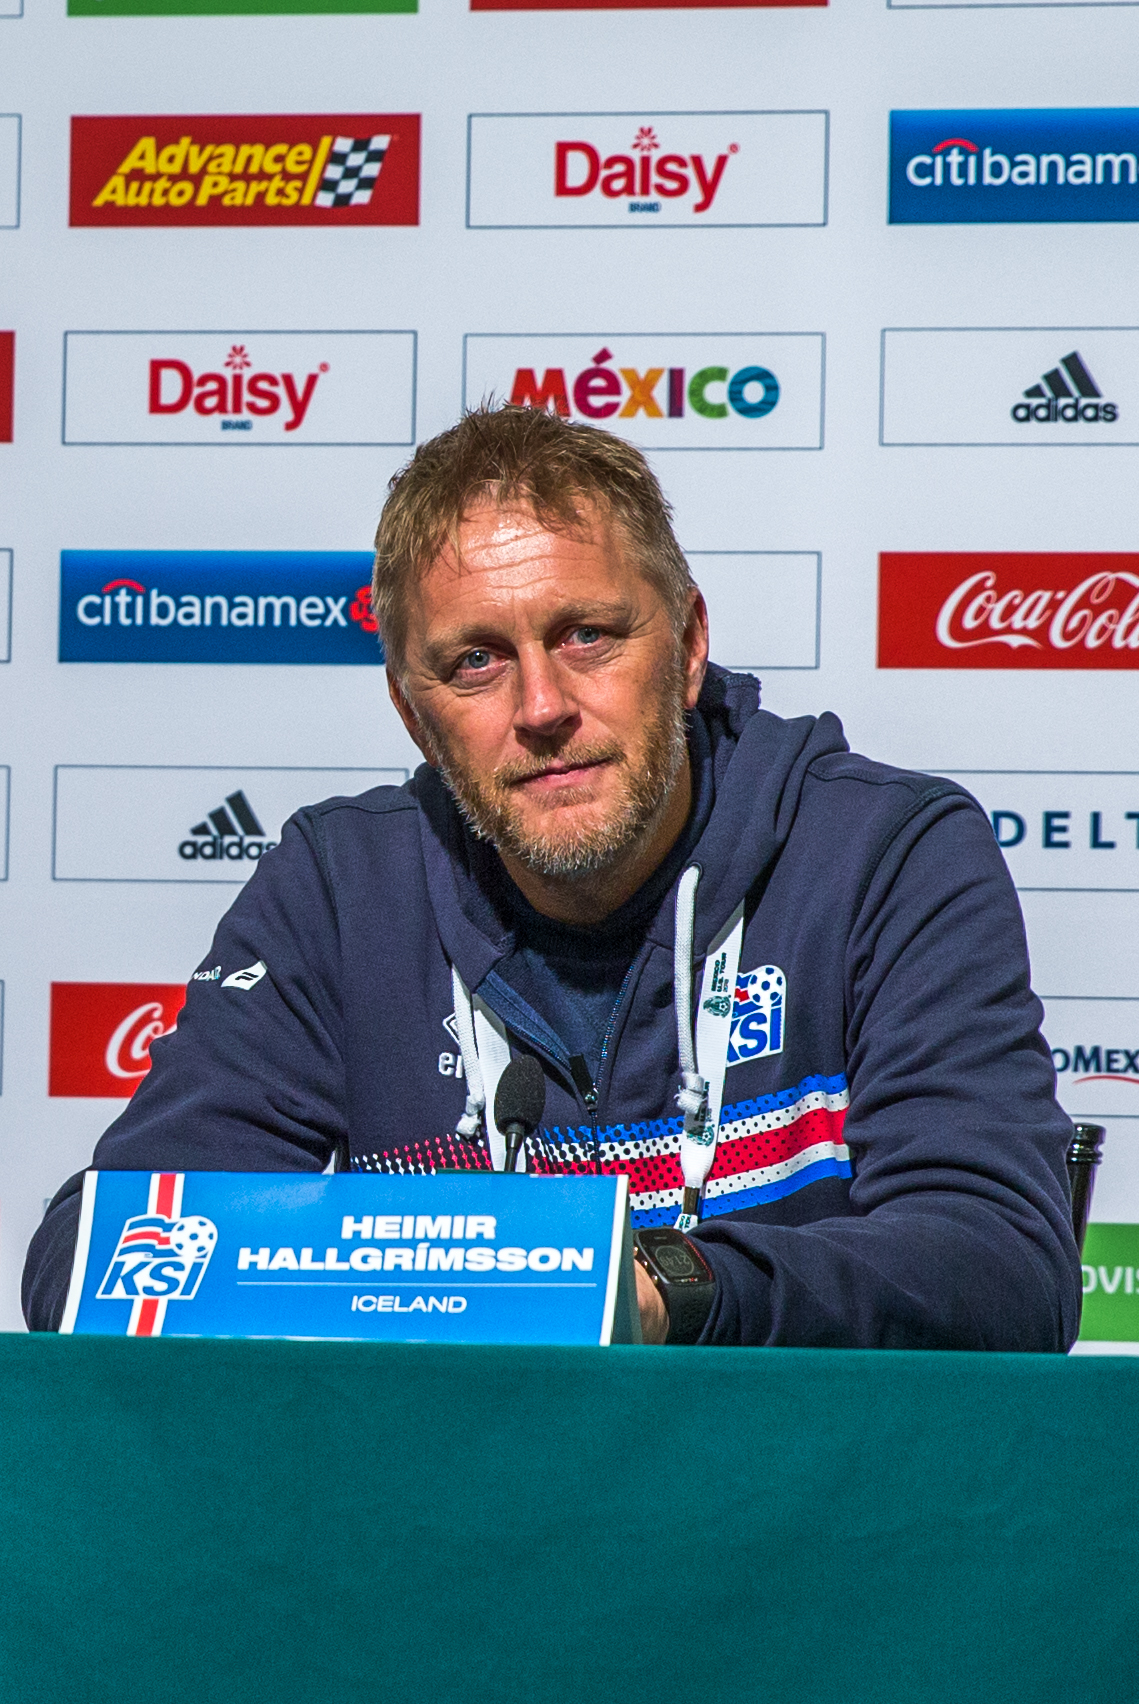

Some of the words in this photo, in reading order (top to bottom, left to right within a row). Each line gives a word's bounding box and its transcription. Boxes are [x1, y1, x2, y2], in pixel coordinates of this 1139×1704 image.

[118, 137, 312, 175] Advance
[555, 127, 728, 213] Daisy
[906, 140, 1139, 186] citibanam
[92, 174, 194, 207] Auto
[195, 174, 301, 207] Parts
[148, 346, 319, 431] Daisy
[1011, 397, 1119, 424] adidas
[77, 580, 348, 627] citibanamex
[340, 1215, 498, 1240] HEIMIR
[236, 1242, 595, 1273] HALLGRÍMSSON
[350, 1295, 468, 1314] ICELAND
